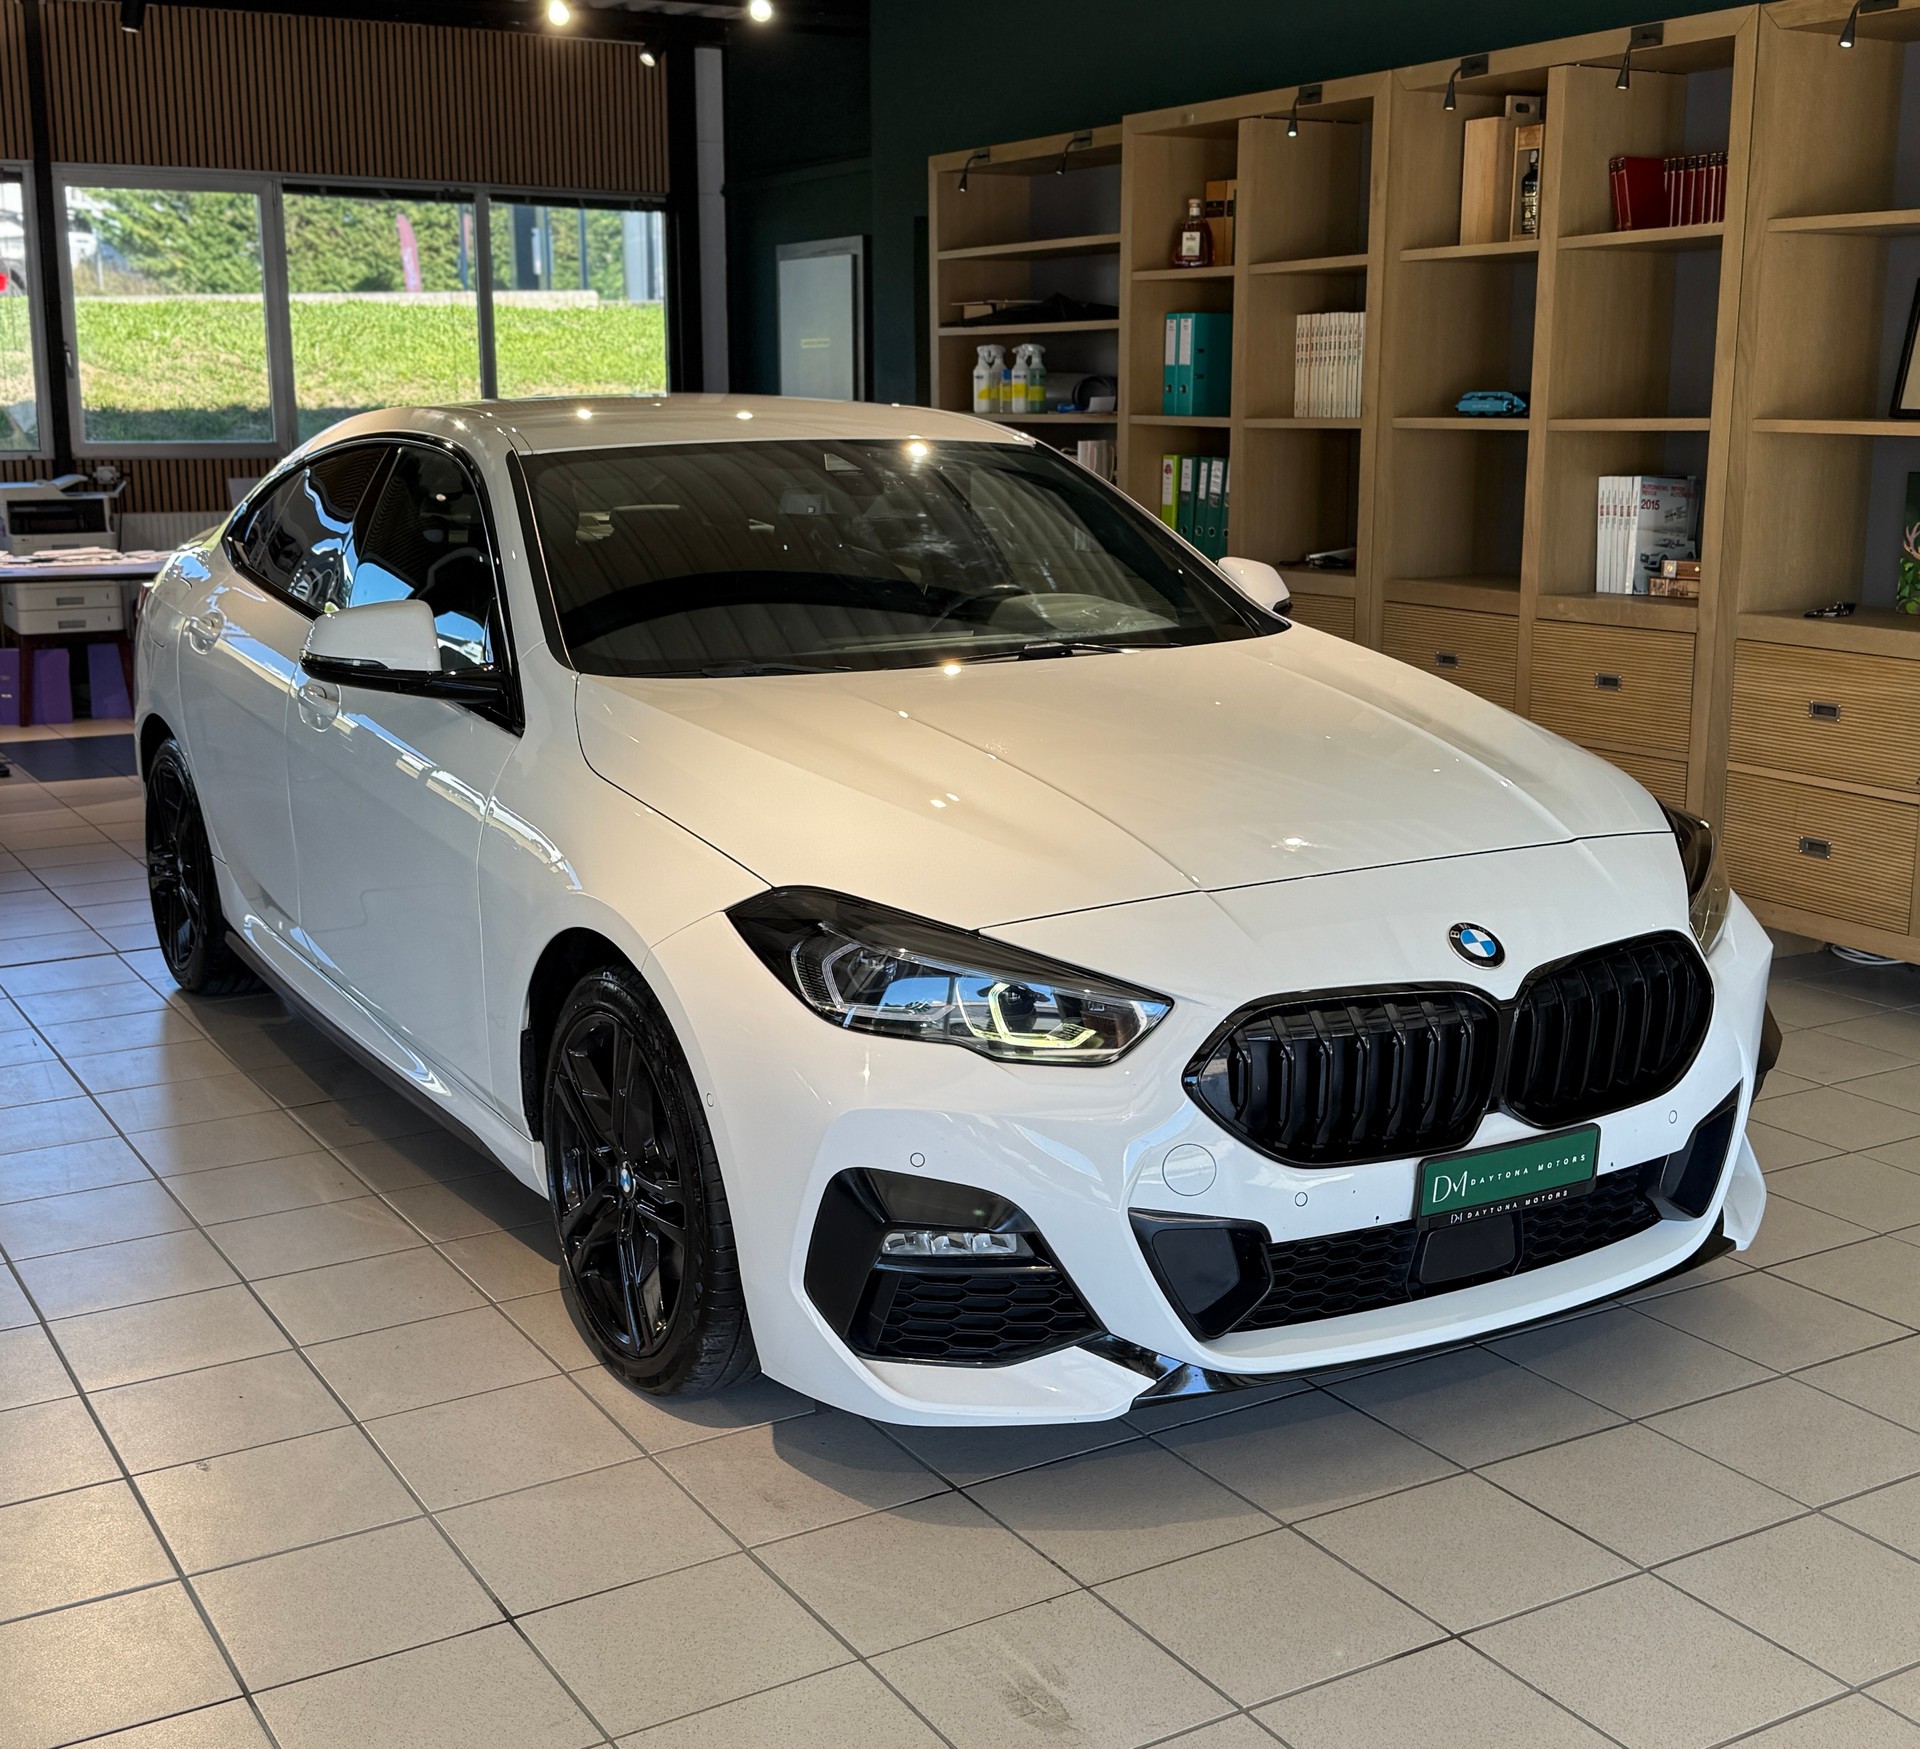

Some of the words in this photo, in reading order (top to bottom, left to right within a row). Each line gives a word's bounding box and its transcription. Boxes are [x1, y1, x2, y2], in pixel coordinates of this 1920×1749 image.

[1640, 499, 1660, 510] 2015
[1470, 1168, 1529, 1186] DAYTONA
[1537, 1154, 1586, 1171] MOTORS
[1467, 1203, 1518, 1219] DAYTONA
[1525, 1190, 1568, 1205] MOTORS
